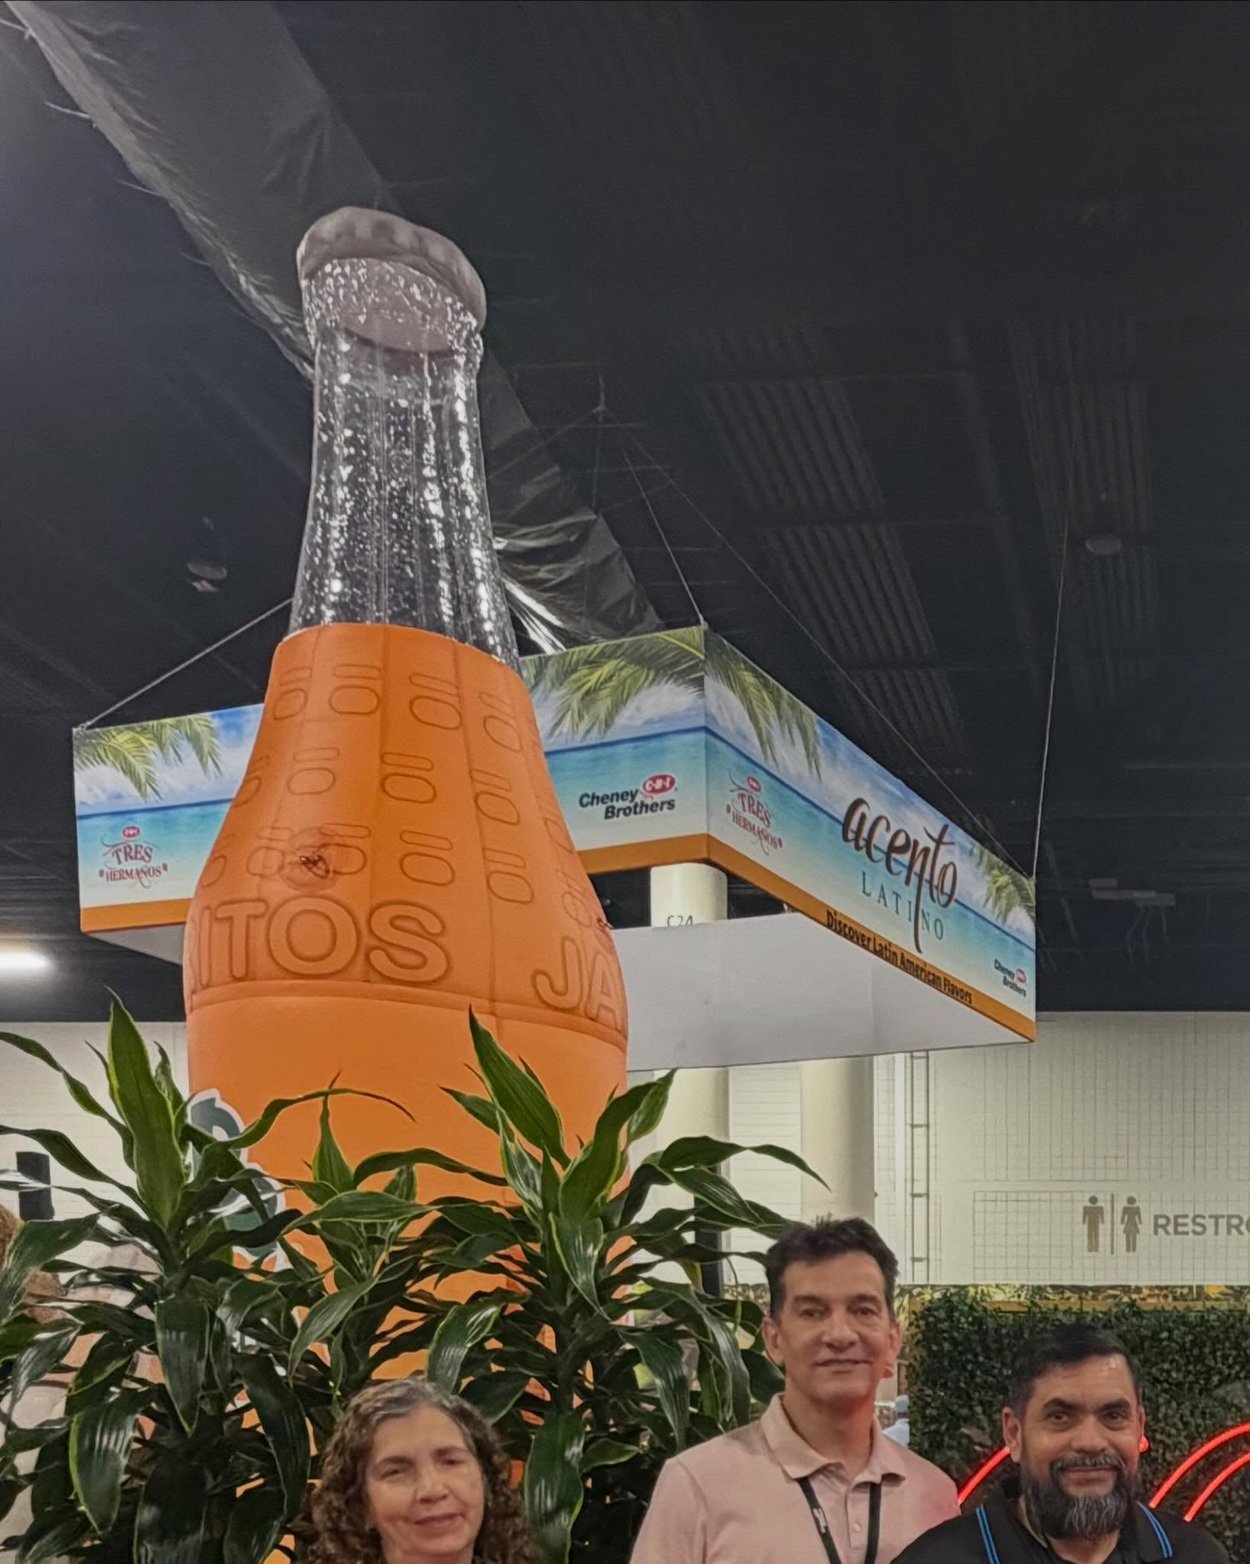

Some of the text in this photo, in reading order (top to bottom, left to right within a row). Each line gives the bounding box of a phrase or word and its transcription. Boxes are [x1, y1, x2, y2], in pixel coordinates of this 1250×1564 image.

[578, 789, 640, 808] Cheney
[604, 799, 676, 820] Brothers
[738, 791, 772, 830] TRES
[112, 843, 153, 865] TRES
[105, 864, 163, 883] HERMANOS
[842, 798, 957, 953] acento
[861, 870, 944, 941] LATINO
[826, 909, 973, 1005] Discover Latin American Flavors
